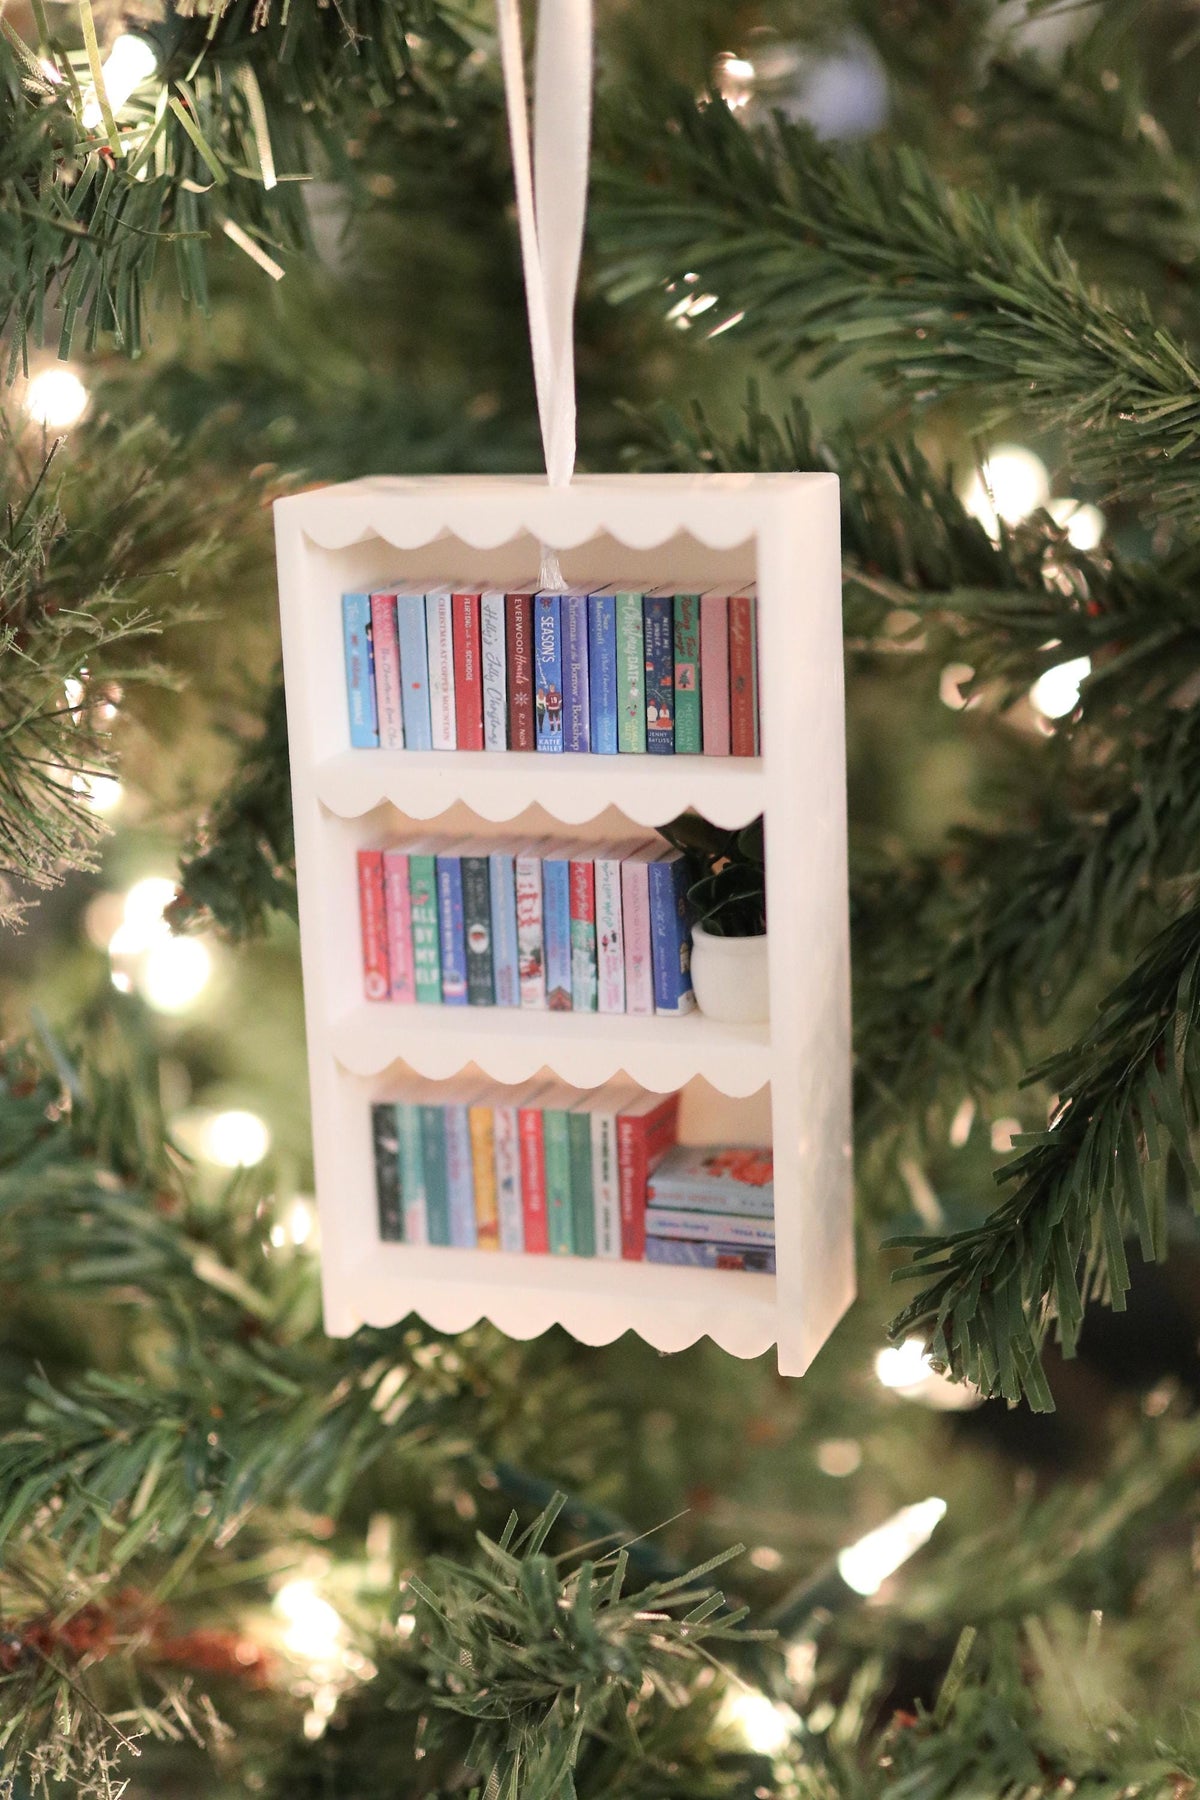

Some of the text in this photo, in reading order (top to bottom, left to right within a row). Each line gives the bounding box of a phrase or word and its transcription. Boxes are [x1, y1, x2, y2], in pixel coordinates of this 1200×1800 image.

[438, 598, 448, 648] CHRISTMAS
[514, 598, 525, 654] EVERWOOD
[568, 596, 579, 641] Christmas
[596, 600, 605, 645] Moorcroft
[603, 613, 611, 631] Sue
[622, 606, 643, 656] Christmas
[541, 616, 555, 663] SEASON'S
[662, 638, 669, 649] ME
[465, 649, 474, 681] SCROOGE
[483, 604, 504, 745] Holly's Jolly Christmas
[515, 654, 530, 685] Hearts
[571, 662, 581, 696] Borrow
[627, 656, 639, 682] DATE
[442, 693, 450, 741] MOUNTAIN
[571, 704, 582, 751] Bookshop
[677, 709, 685, 746] QUINN
[685, 702, 693, 751] MEGHAN
[412, 906, 436, 923] ALL
[414, 927, 434, 943] BY
[415, 948, 435, 963] MY
[415, 968, 438, 985] ELF
